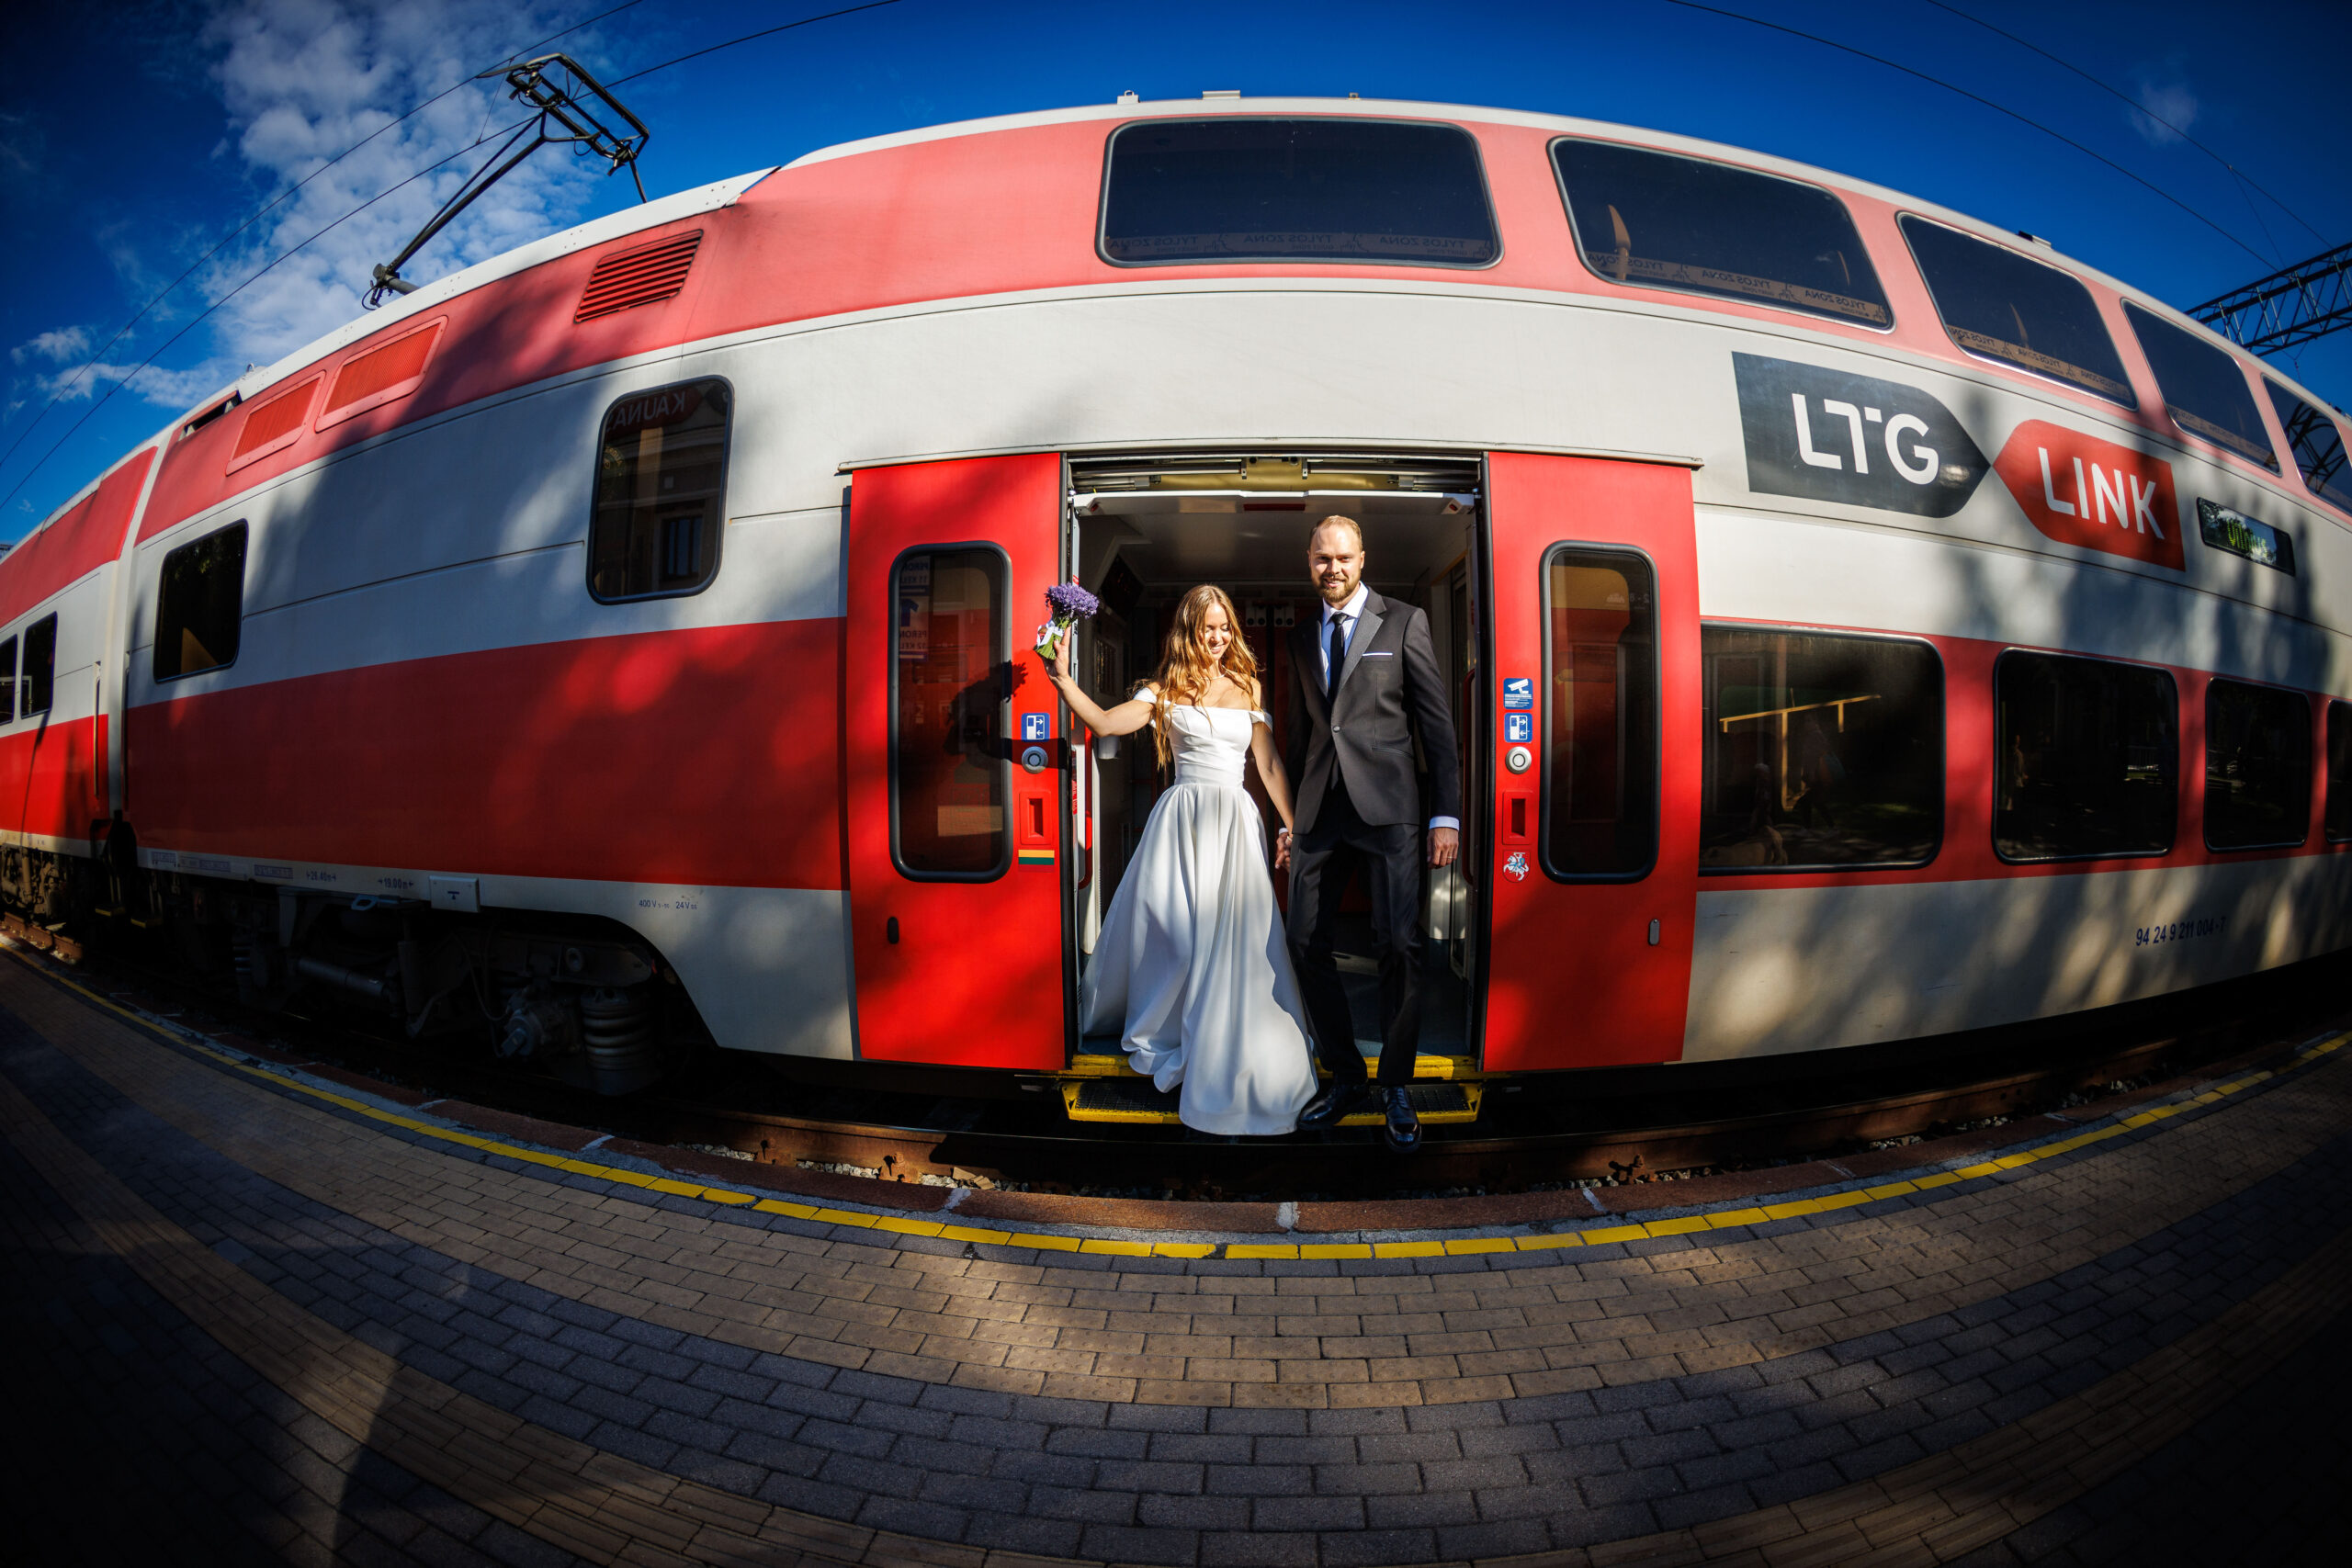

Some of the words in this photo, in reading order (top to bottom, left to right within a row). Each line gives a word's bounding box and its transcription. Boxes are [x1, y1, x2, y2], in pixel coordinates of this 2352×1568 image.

[1792, 392, 1939, 485] LTG
[2038, 446, 2165, 540] LINK
[2135, 928, 2150, 946] 94
[2154, 925, 2167, 944] 24
[2170, 923, 2177, 942] 9
[2178, 921, 2195, 940] 211
